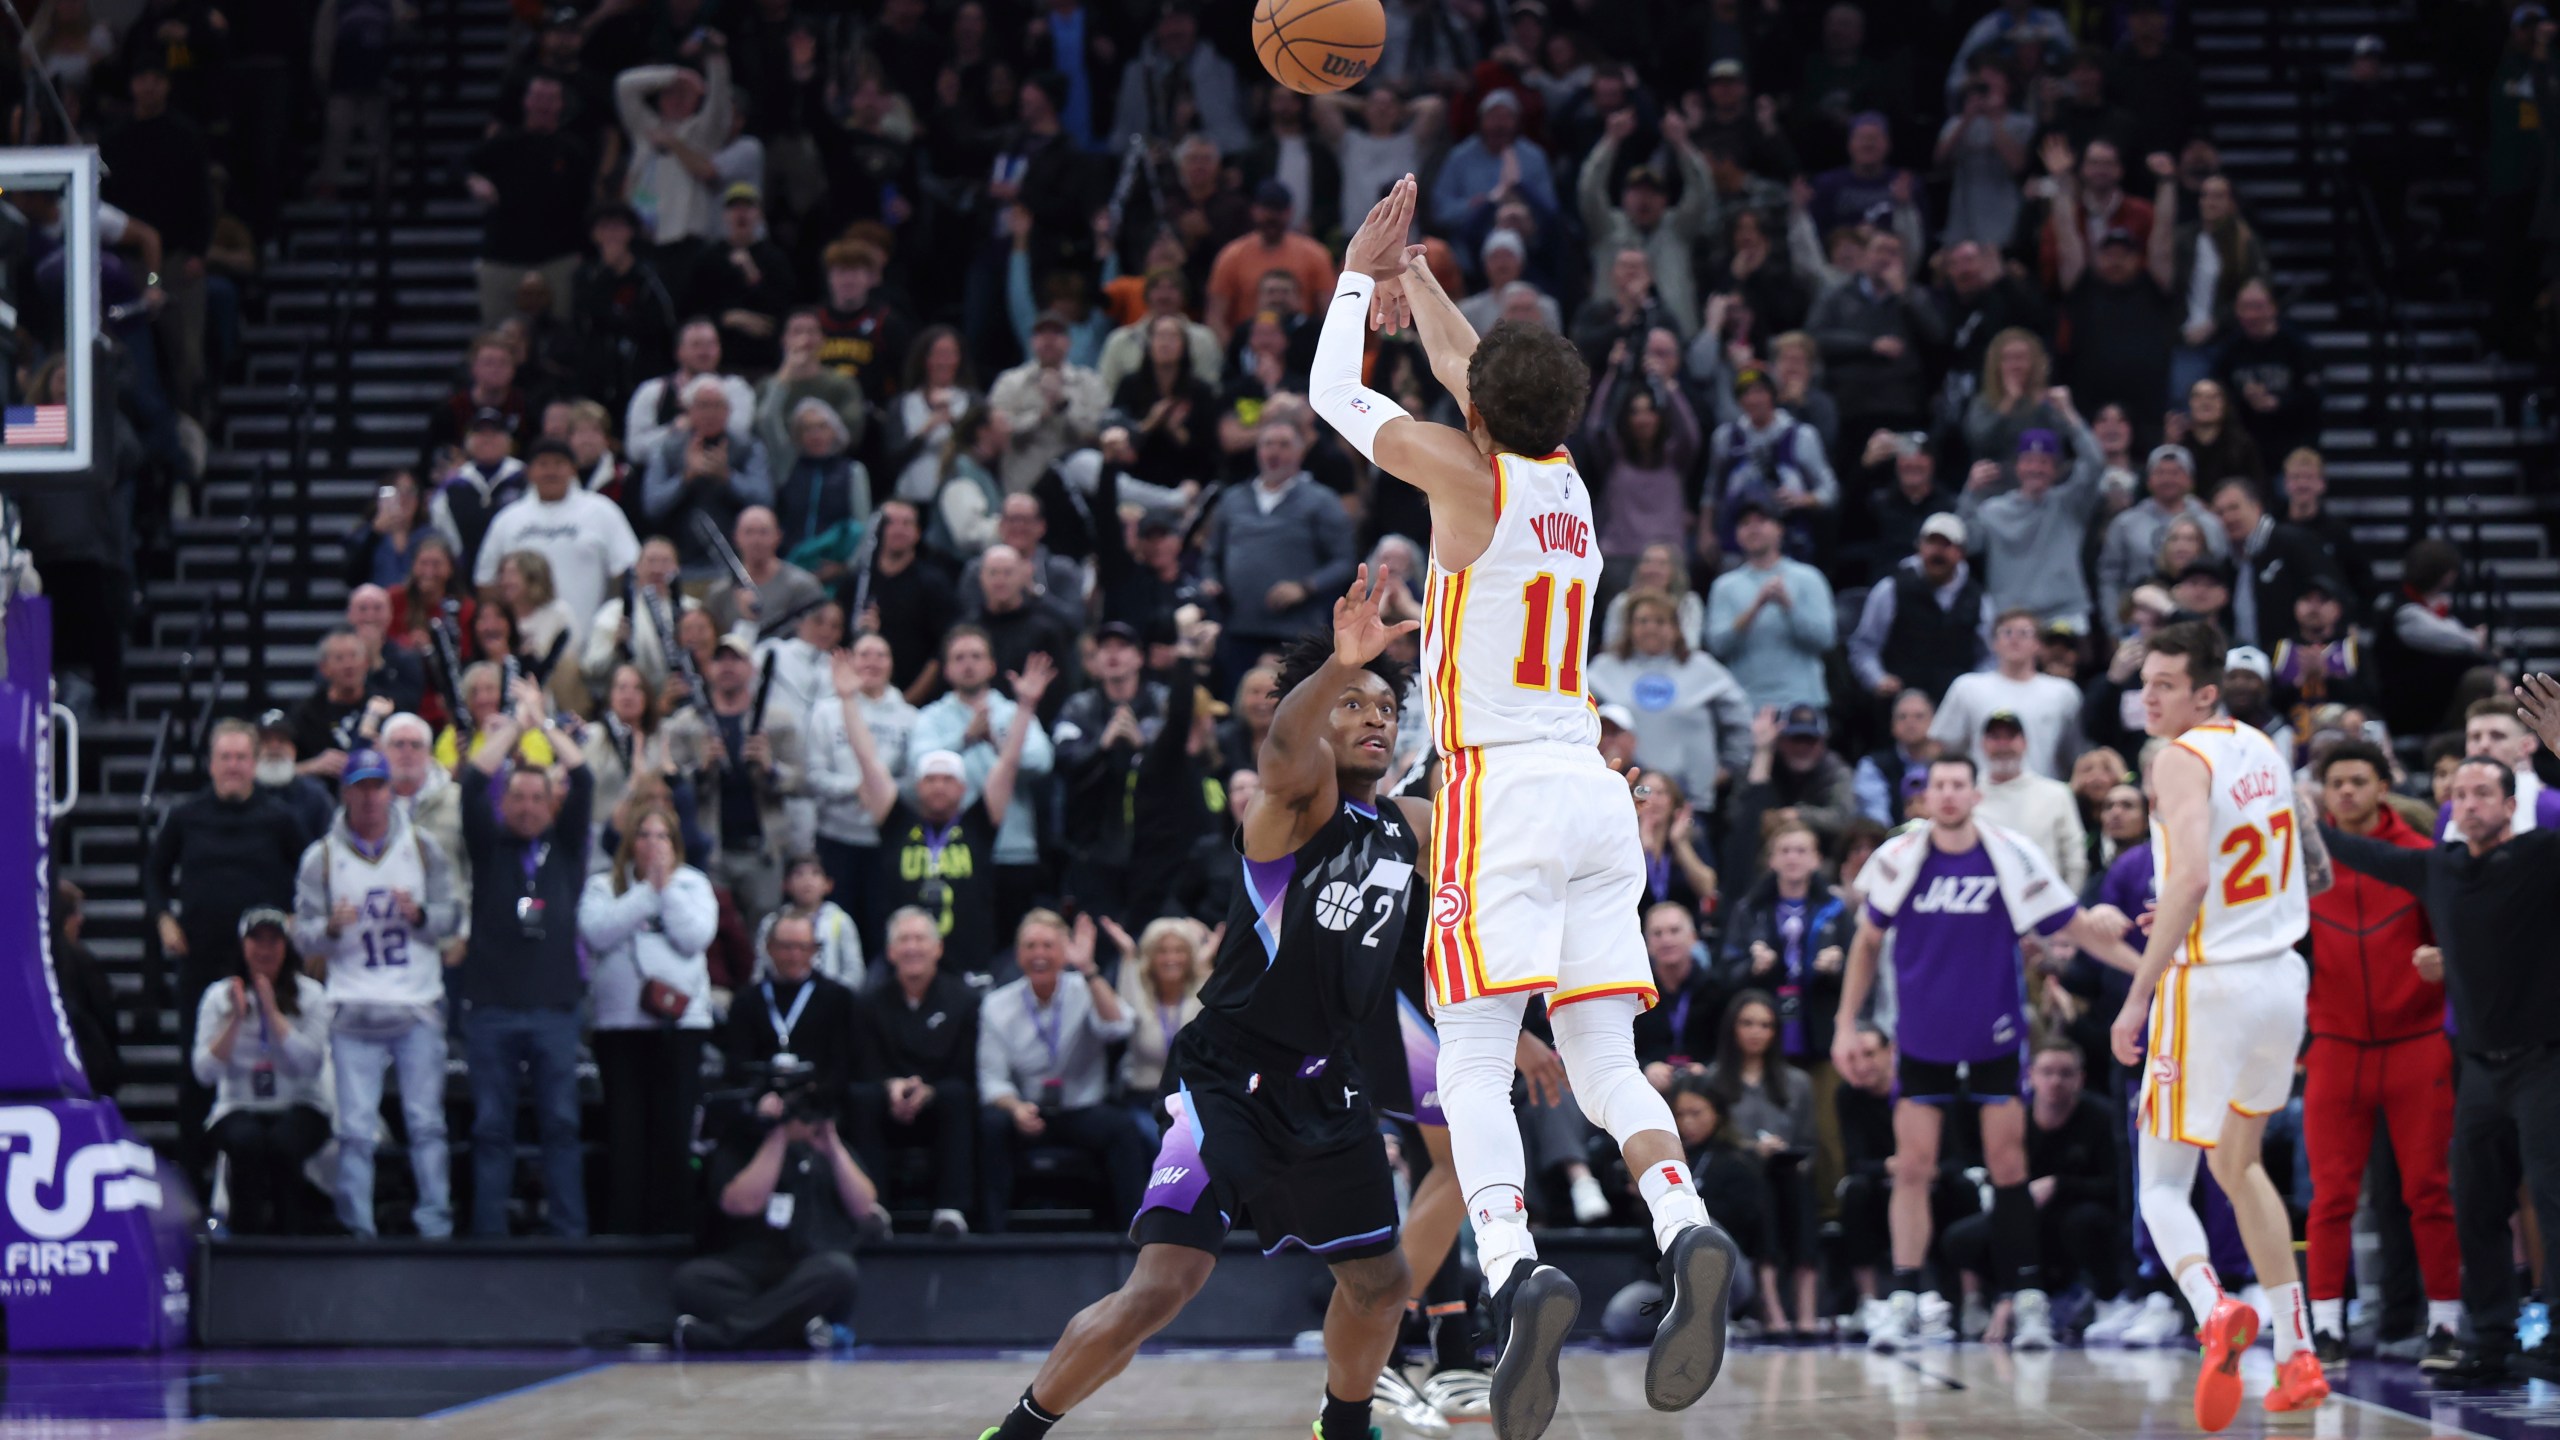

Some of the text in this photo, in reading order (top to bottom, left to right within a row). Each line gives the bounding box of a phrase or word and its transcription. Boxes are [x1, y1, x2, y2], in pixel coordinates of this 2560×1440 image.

[1530, 512, 1588, 559] YOUNG
[1513, 571, 1586, 698] 11
[2220, 808, 2294, 908] 27
[1912, 875, 1999, 914] JAZZ
[1361, 894, 1395, 948] 2
[361, 928, 409, 967] 12
[1149, 1166, 1190, 1190] UTAH
[5, 1240, 119, 1277] FIRST
